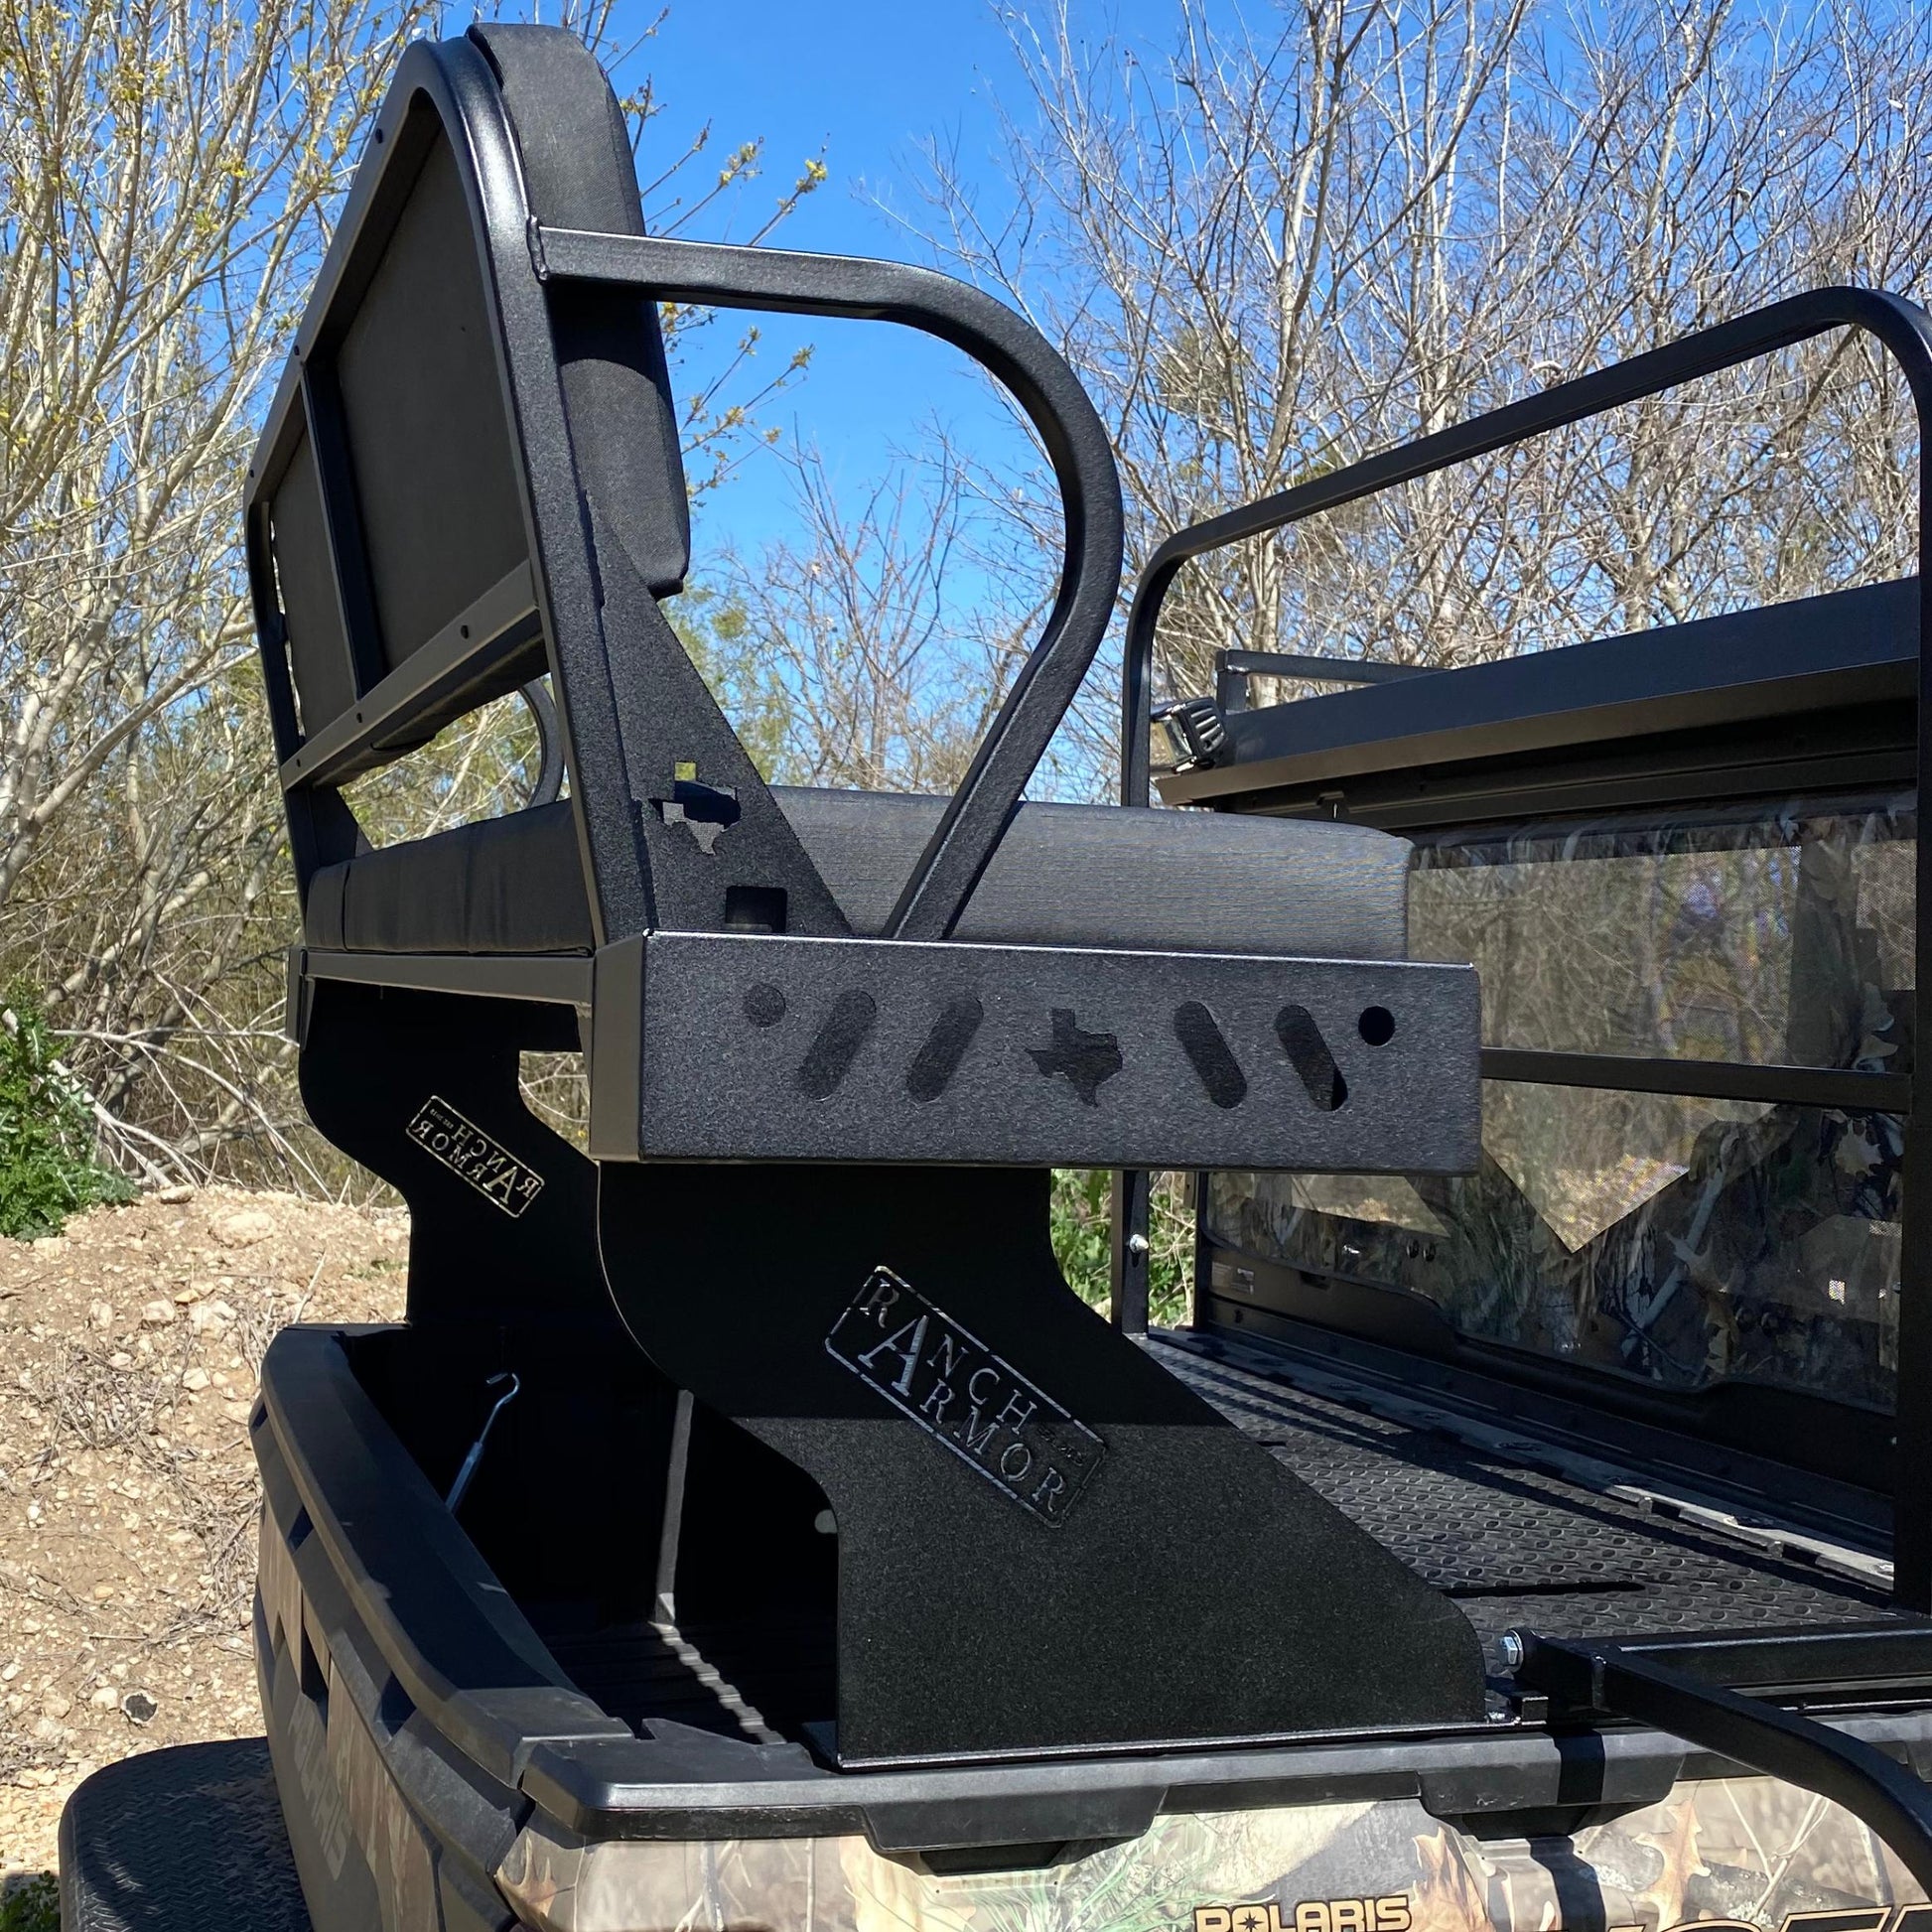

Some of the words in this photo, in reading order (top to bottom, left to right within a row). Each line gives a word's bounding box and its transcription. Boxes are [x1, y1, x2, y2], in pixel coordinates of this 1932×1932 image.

[858, 1278, 1037, 1435] RANCH
[858, 1314, 1066, 1514] ARMOR
[1193, 1894, 1413, 1932] POLARIS
